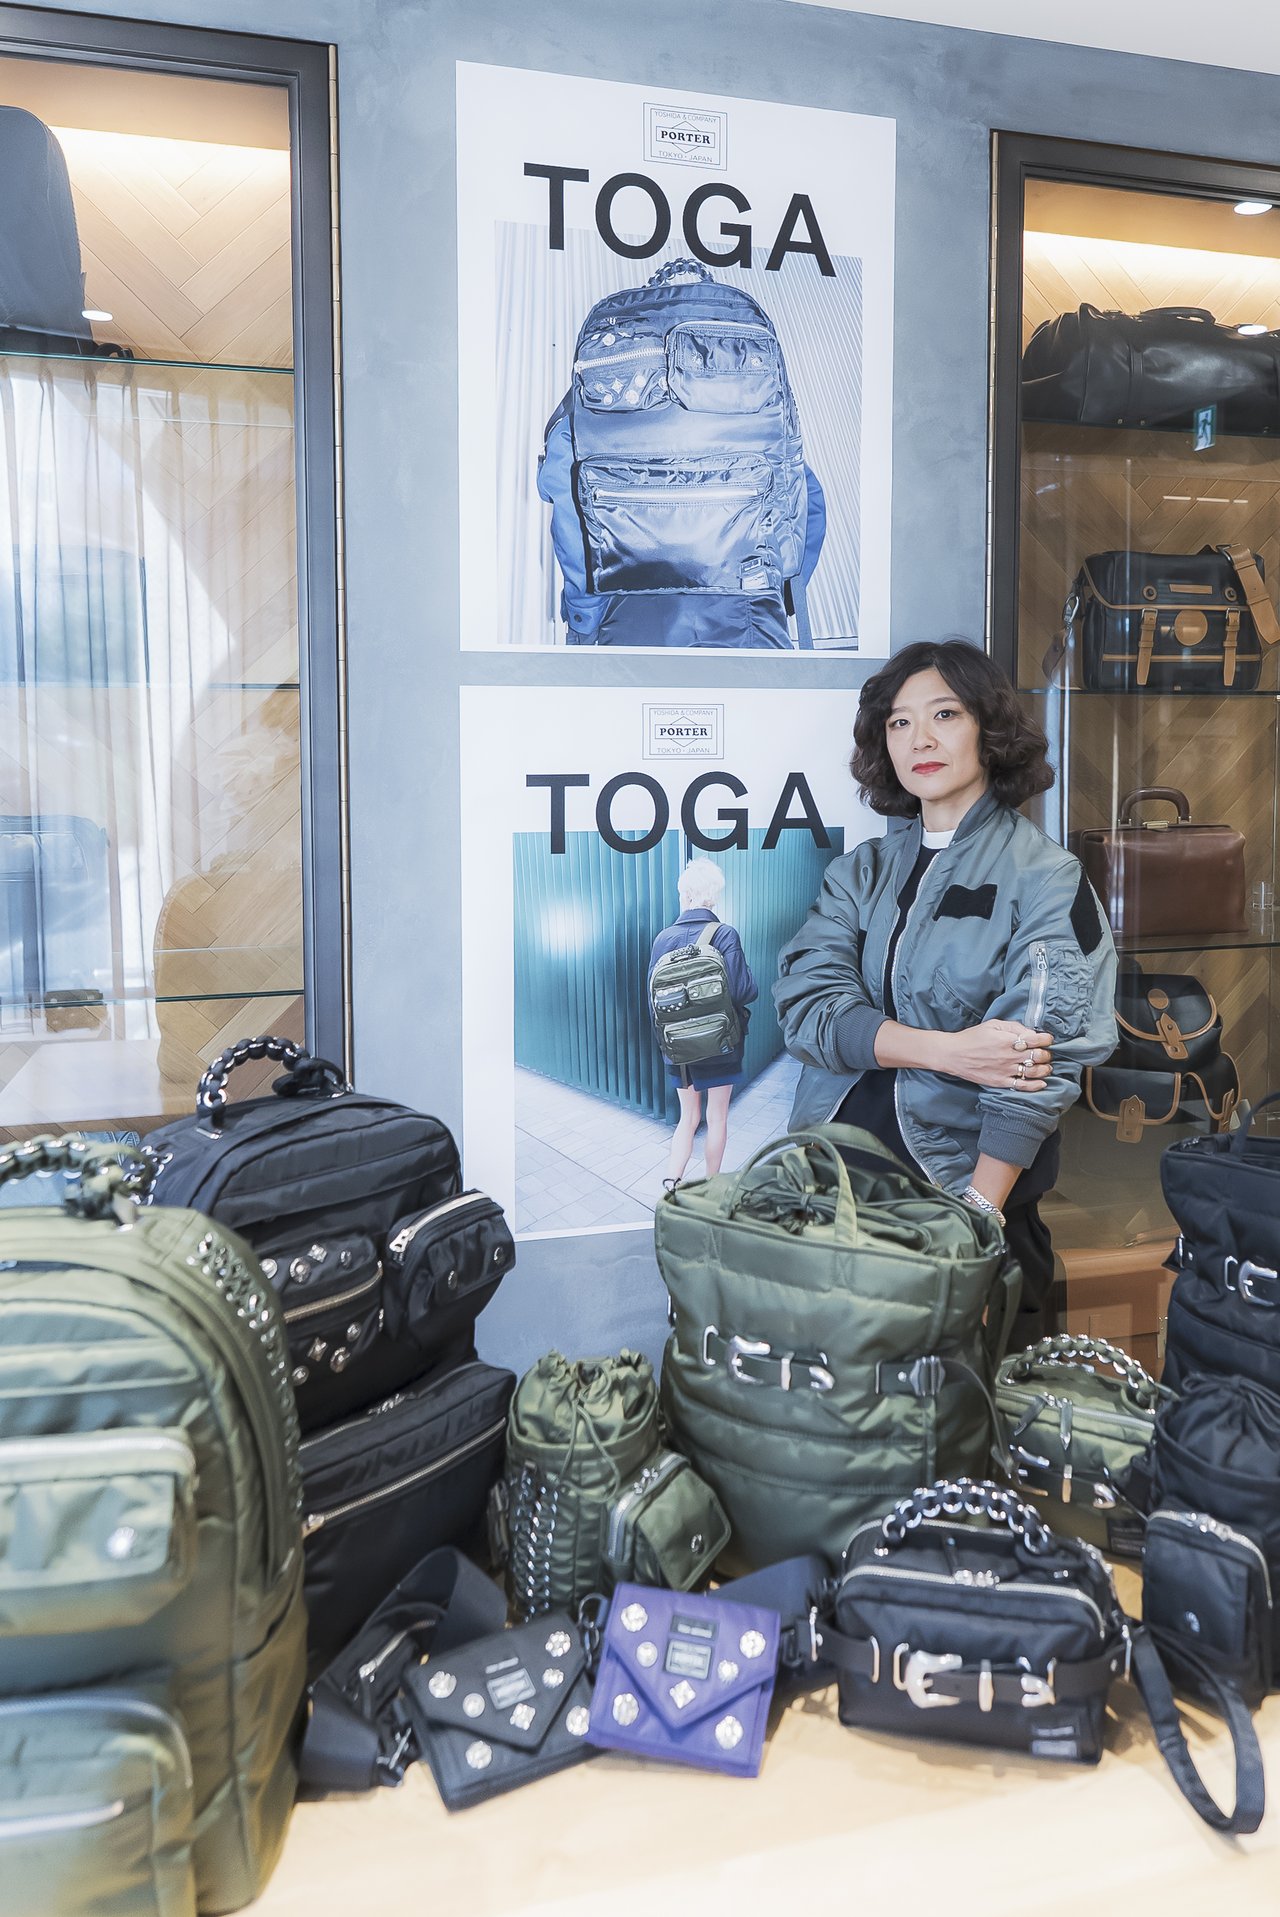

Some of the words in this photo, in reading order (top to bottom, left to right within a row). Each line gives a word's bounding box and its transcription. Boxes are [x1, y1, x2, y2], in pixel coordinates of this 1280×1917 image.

[654, 111, 681, 119] YOSHIDA
[687, 114, 717, 123] COMPANY
[661, 130, 711, 144] PORTER
[658, 151, 683, 159] TOKYO
[689, 154, 713, 163] JAPAN
[523, 162, 837, 278] TOGA
[659, 727, 708, 736] PORTER
[525, 771, 832, 854] TOGA
